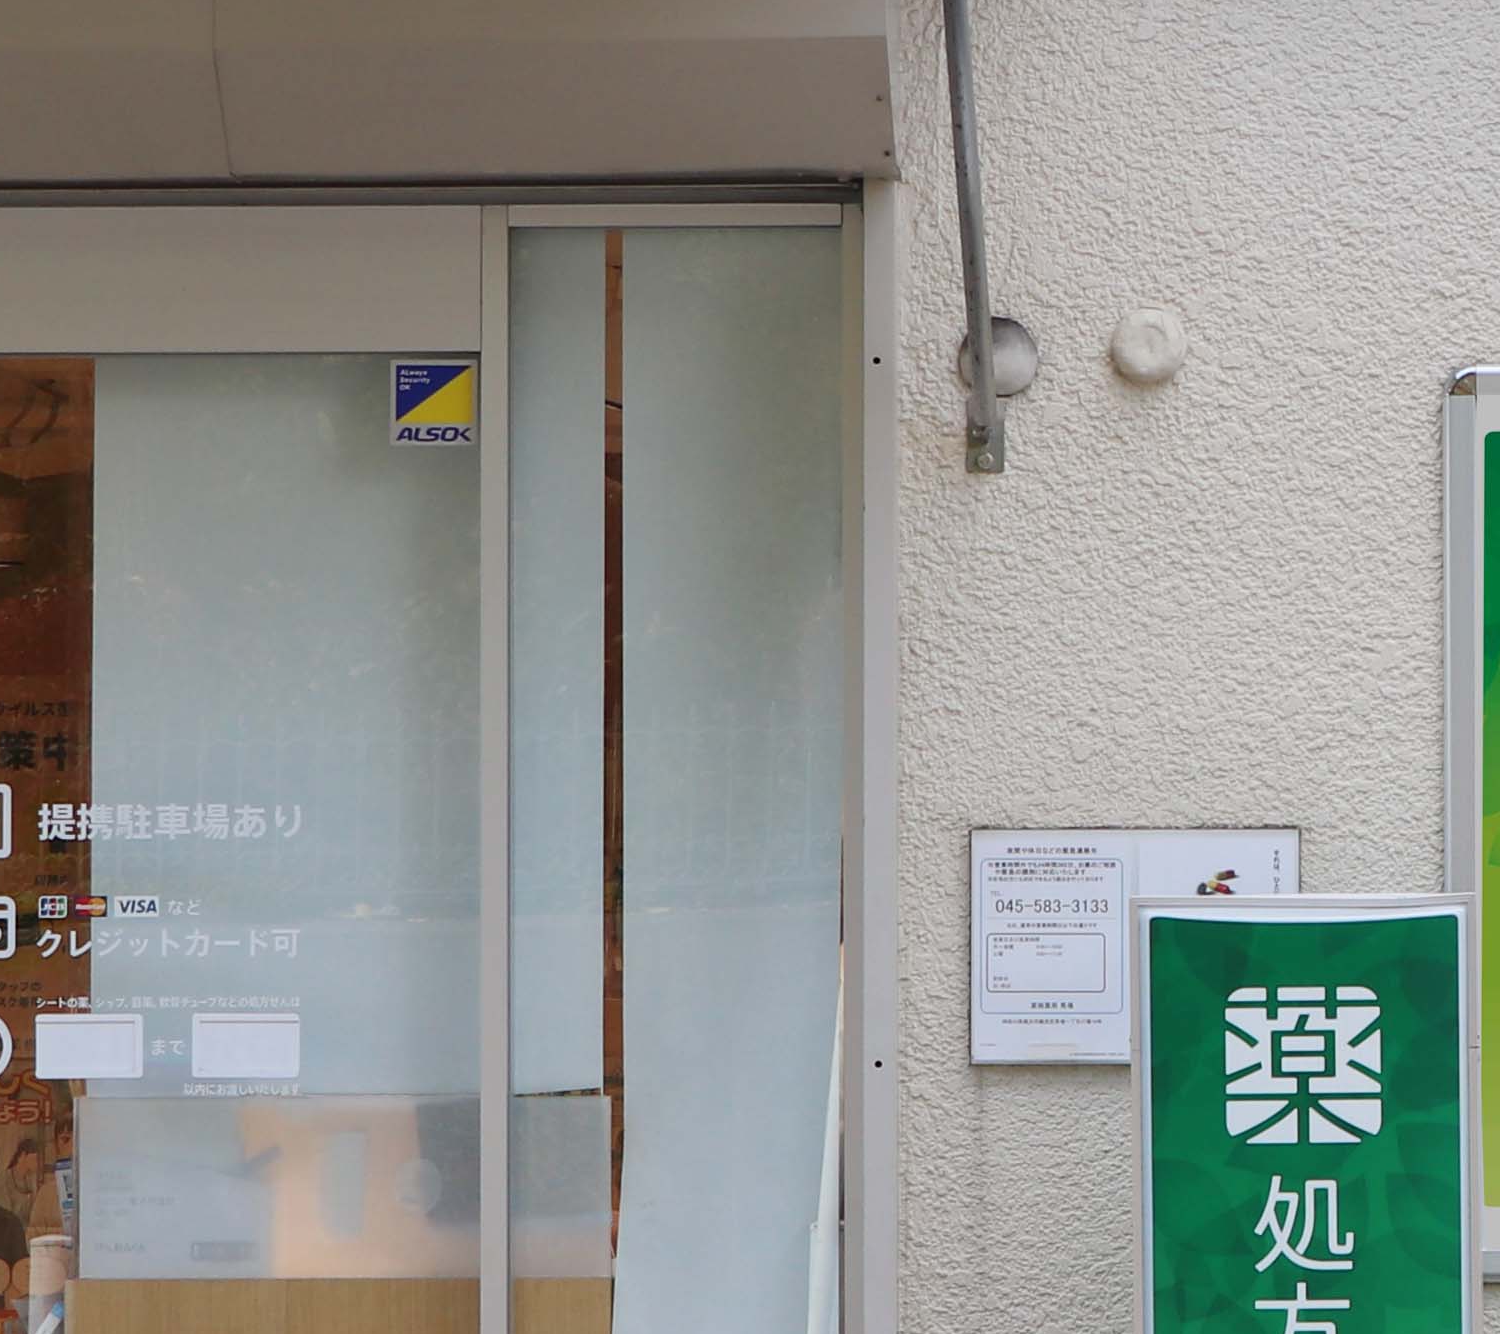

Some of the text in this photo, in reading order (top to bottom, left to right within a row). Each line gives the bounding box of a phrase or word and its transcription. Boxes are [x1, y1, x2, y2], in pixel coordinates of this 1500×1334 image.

[395, 426, 472, 442] ALSOK
[37, 803, 302, 842] 提携駐車場あり
[119, 899, 158, 914] VISA
[167, 898, 201, 916] など
[995, 899, 1109, 914] 045-583-3133
[35, 928, 301, 959] クレジットカード可
[151, 1039, 185, 1057] まで
